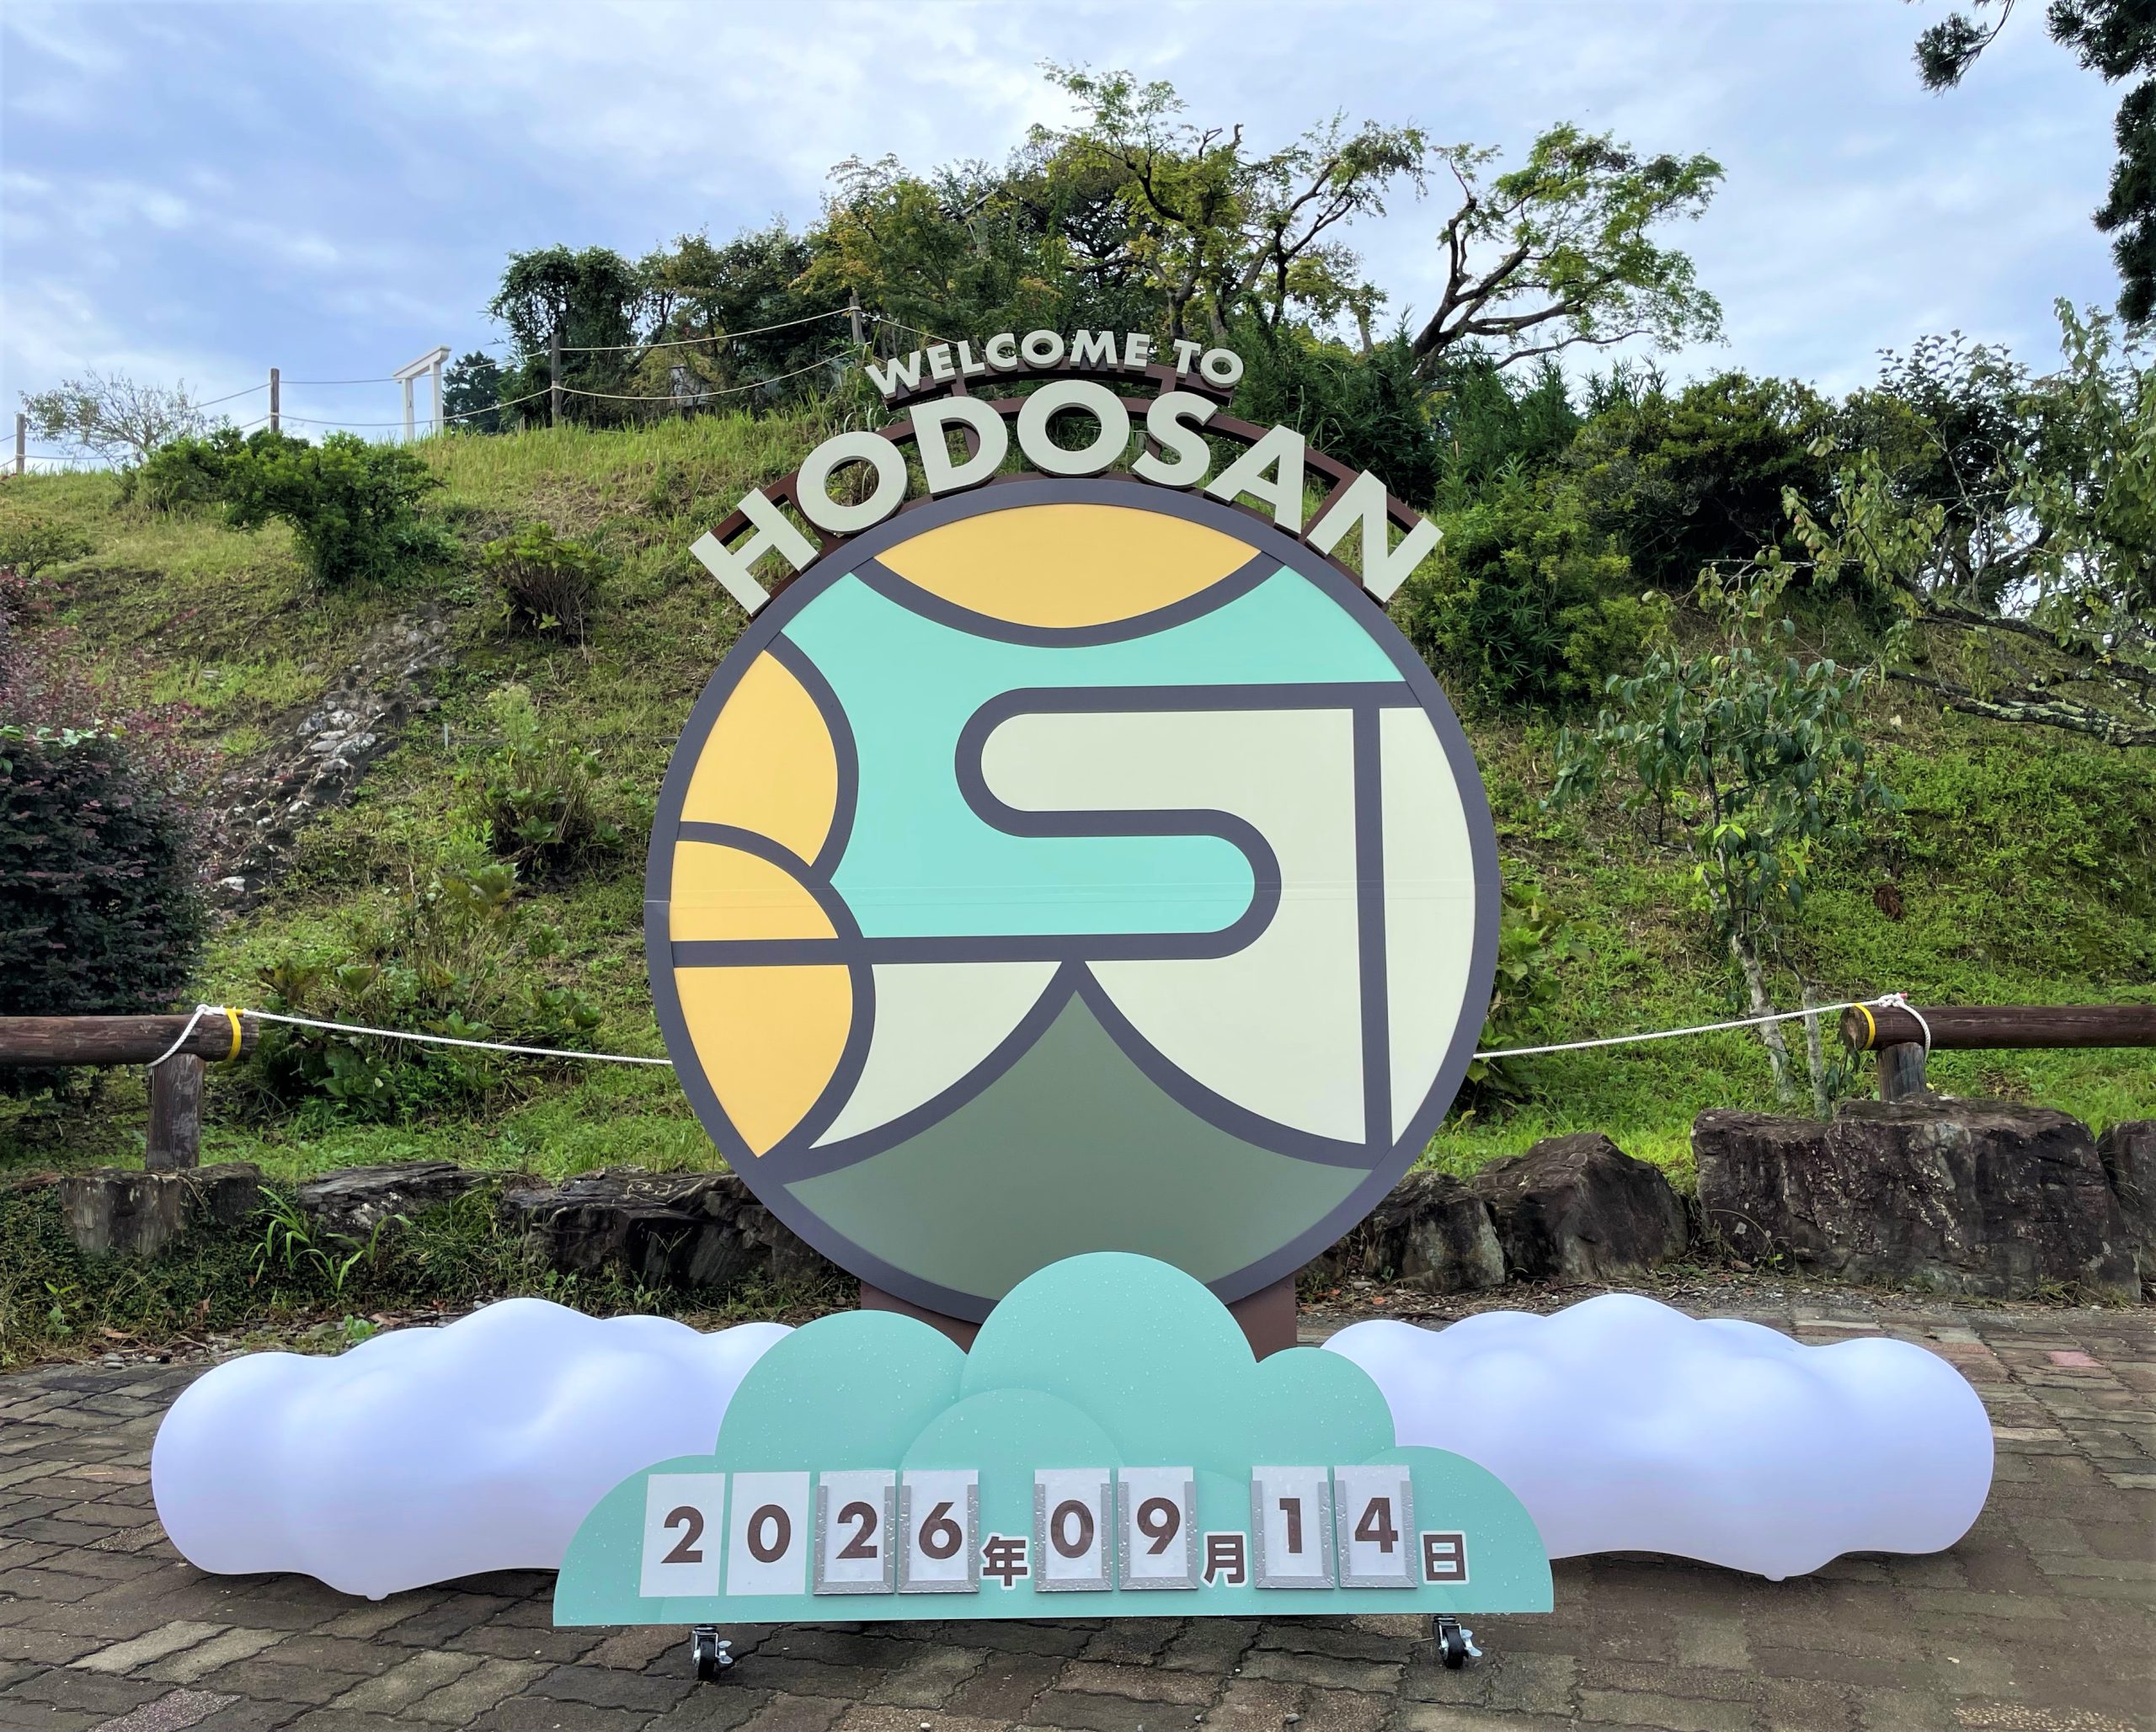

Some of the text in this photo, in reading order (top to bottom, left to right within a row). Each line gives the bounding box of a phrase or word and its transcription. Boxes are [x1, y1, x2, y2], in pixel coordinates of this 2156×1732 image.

[865, 329, 1244, 399] WELCOME TO
[688, 379, 1444, 616] HODOSAN
